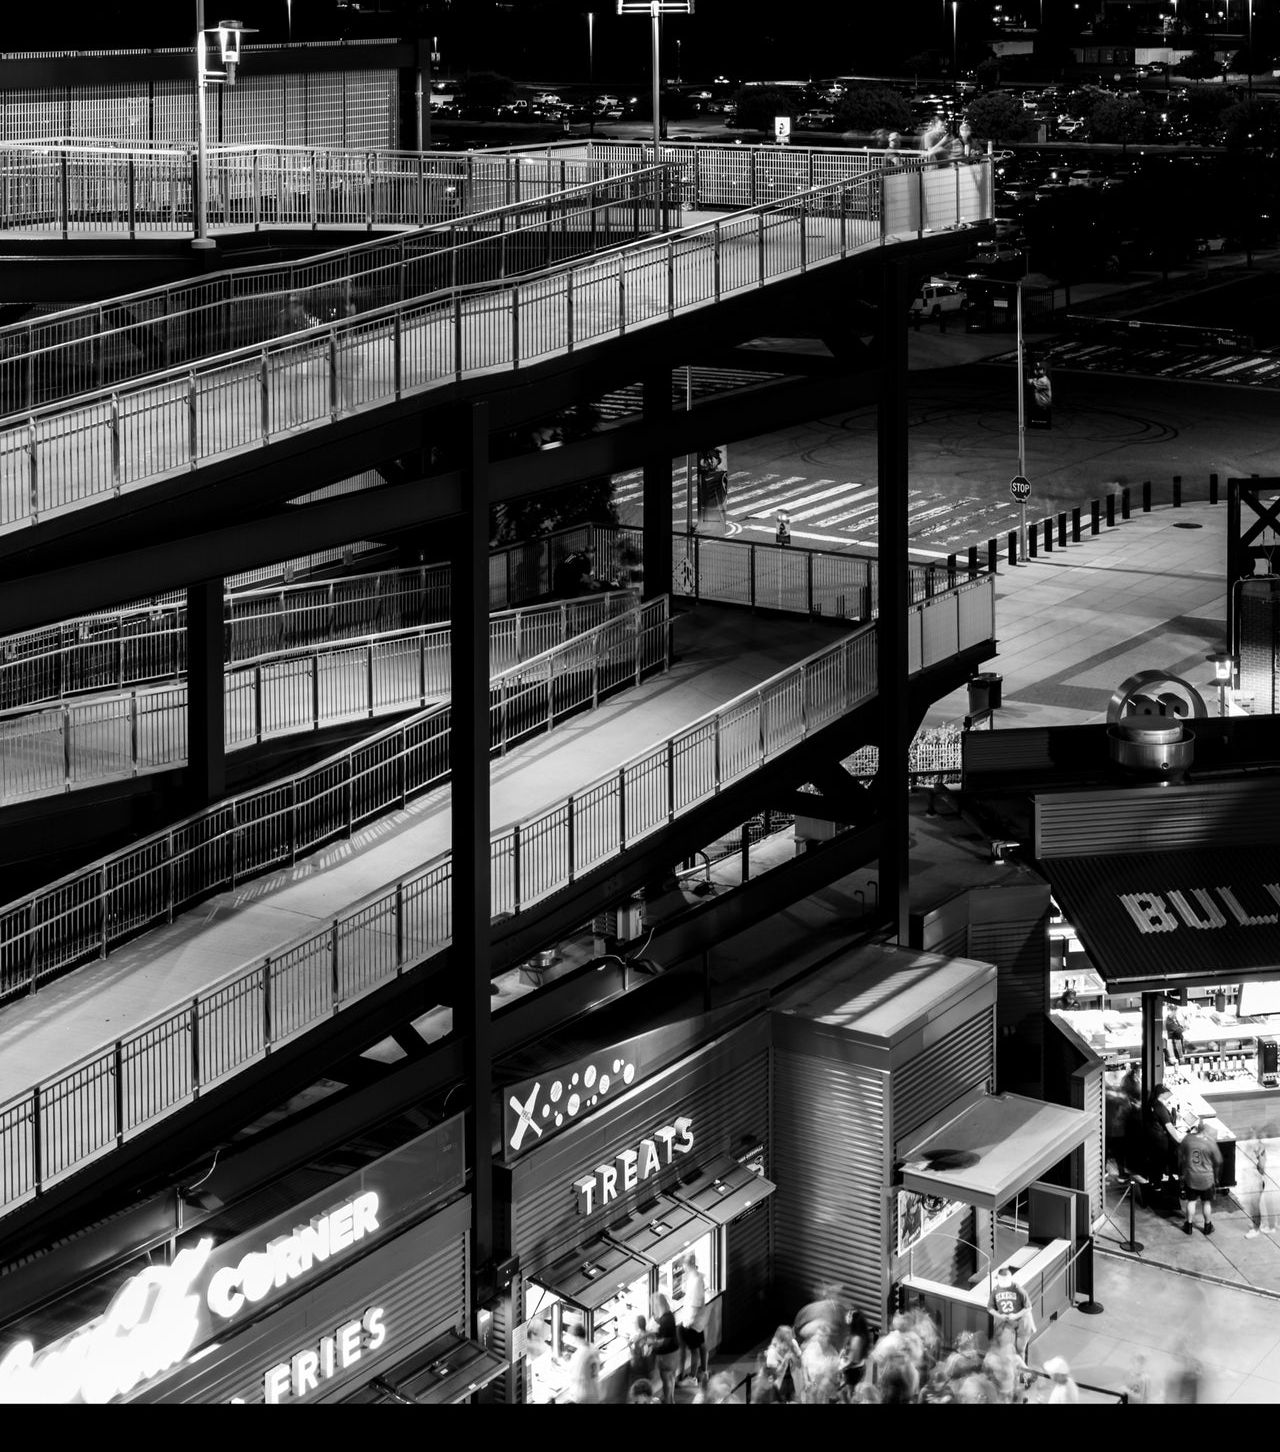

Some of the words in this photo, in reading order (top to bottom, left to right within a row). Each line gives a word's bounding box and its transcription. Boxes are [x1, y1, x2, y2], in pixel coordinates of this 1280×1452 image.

[1012, 482, 1029, 493] STOP
[574, 1116, 695, 1216] TREATS
[206, 1191, 380, 1318] CORNER
[264, 1306, 387, 1405] FRIES
[1000, 1300, 1015, 1313] 23
